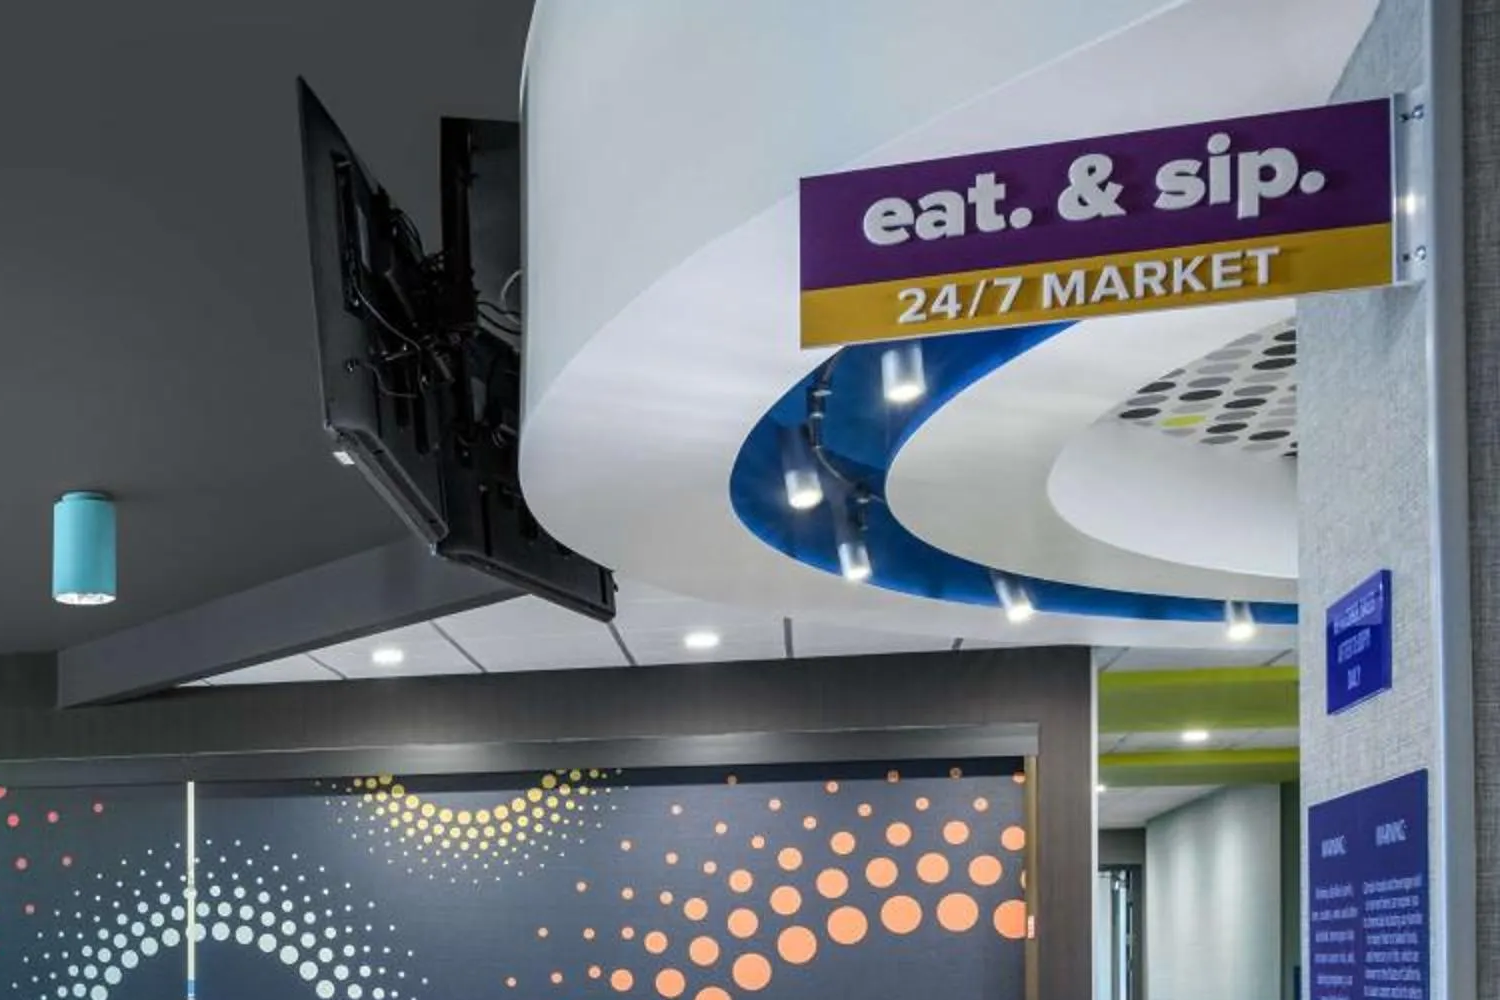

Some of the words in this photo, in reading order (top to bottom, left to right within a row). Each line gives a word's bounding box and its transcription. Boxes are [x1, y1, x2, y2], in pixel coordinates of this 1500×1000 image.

[863, 172, 1033, 246] eat.
[1057, 153, 1126, 222] &
[1154, 132, 1325, 220] sip.
[897, 277, 1022, 325] 24/7
[1041, 246, 1282, 310] MARKET
